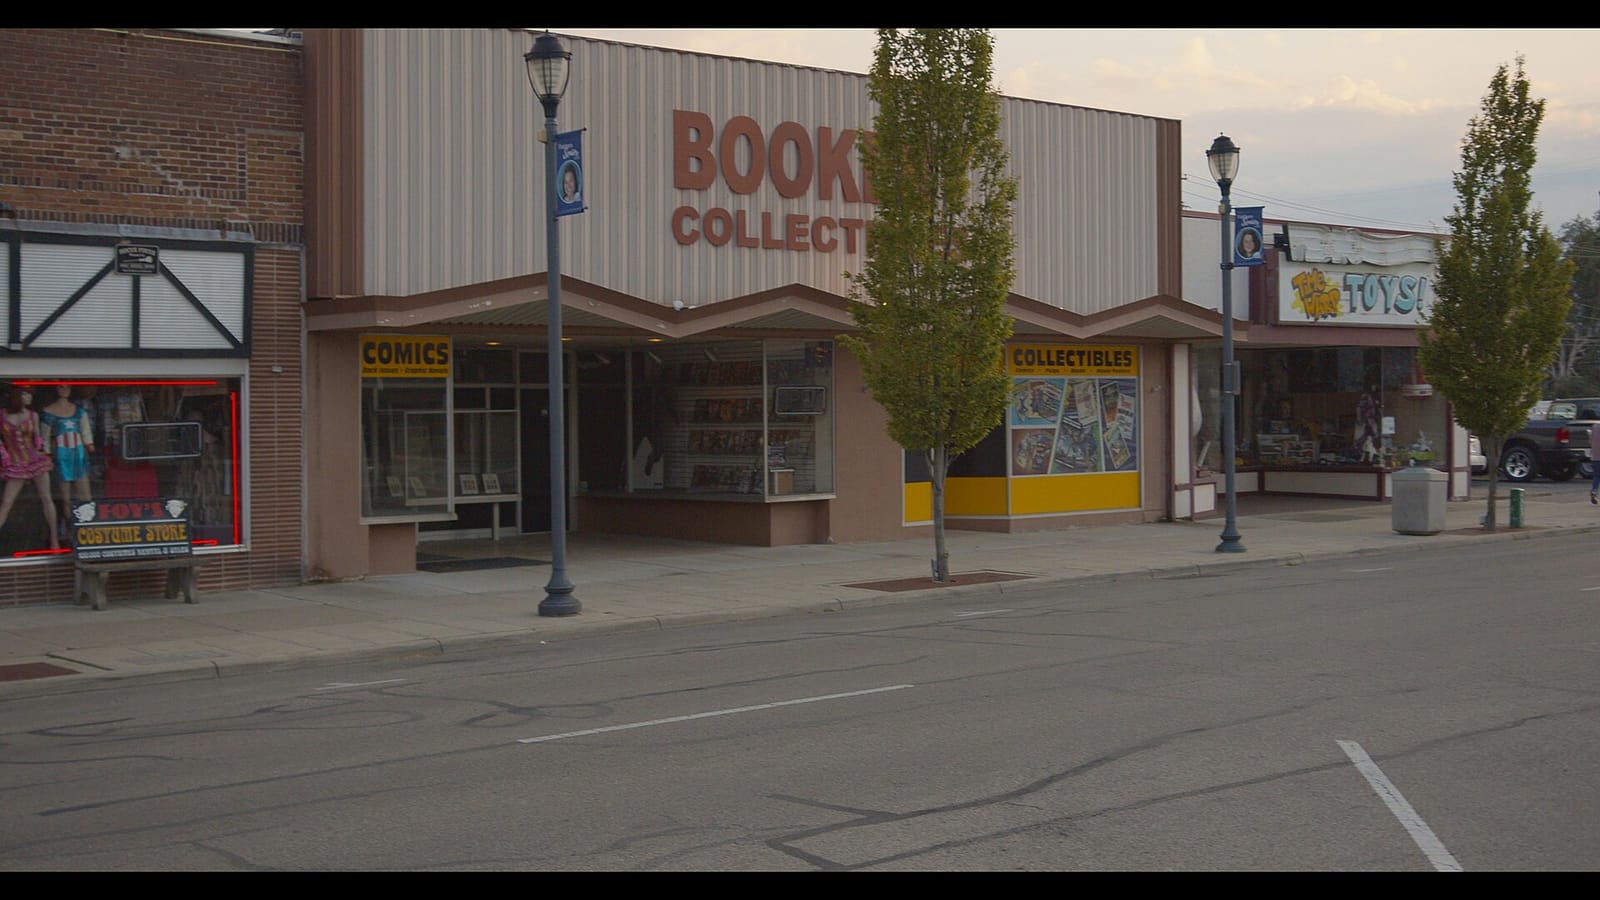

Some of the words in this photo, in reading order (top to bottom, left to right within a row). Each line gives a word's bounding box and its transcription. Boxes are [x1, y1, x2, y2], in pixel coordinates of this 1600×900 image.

[671, 205, 876, 255] COLLECT
[1344, 272, 1427, 315] TOYS!
[363, 341, 449, 365] COMICS
[1013, 348, 1133, 367] COLLECTIBLES
[98, 502, 165, 520] FOY'S
[77, 525, 142, 545] COSTUME
[144, 524, 188, 542] STORE
